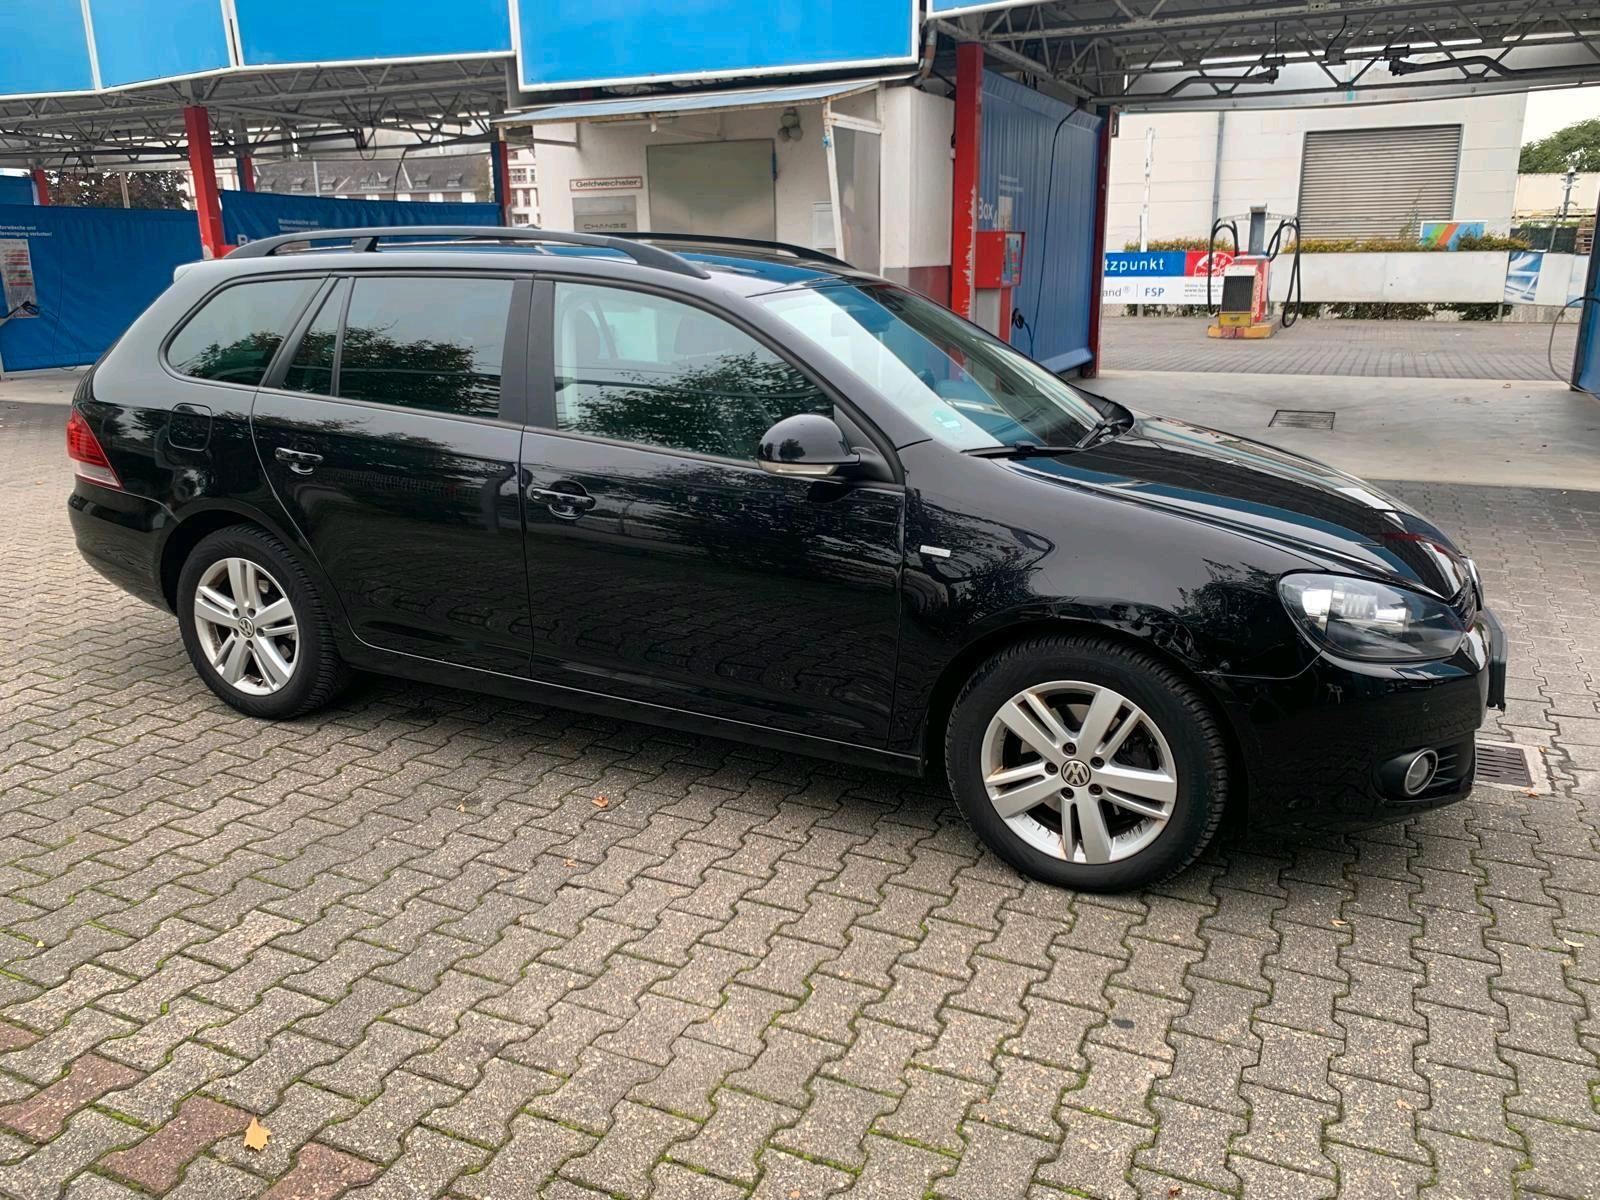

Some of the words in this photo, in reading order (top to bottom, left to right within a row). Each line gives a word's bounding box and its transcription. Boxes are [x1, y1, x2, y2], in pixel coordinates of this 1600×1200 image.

[575, 180, 638, 188] Geldwechsler
[1105, 258, 1165, 273] tzpunkt
[1145, 287, 1165, 297] FSP
